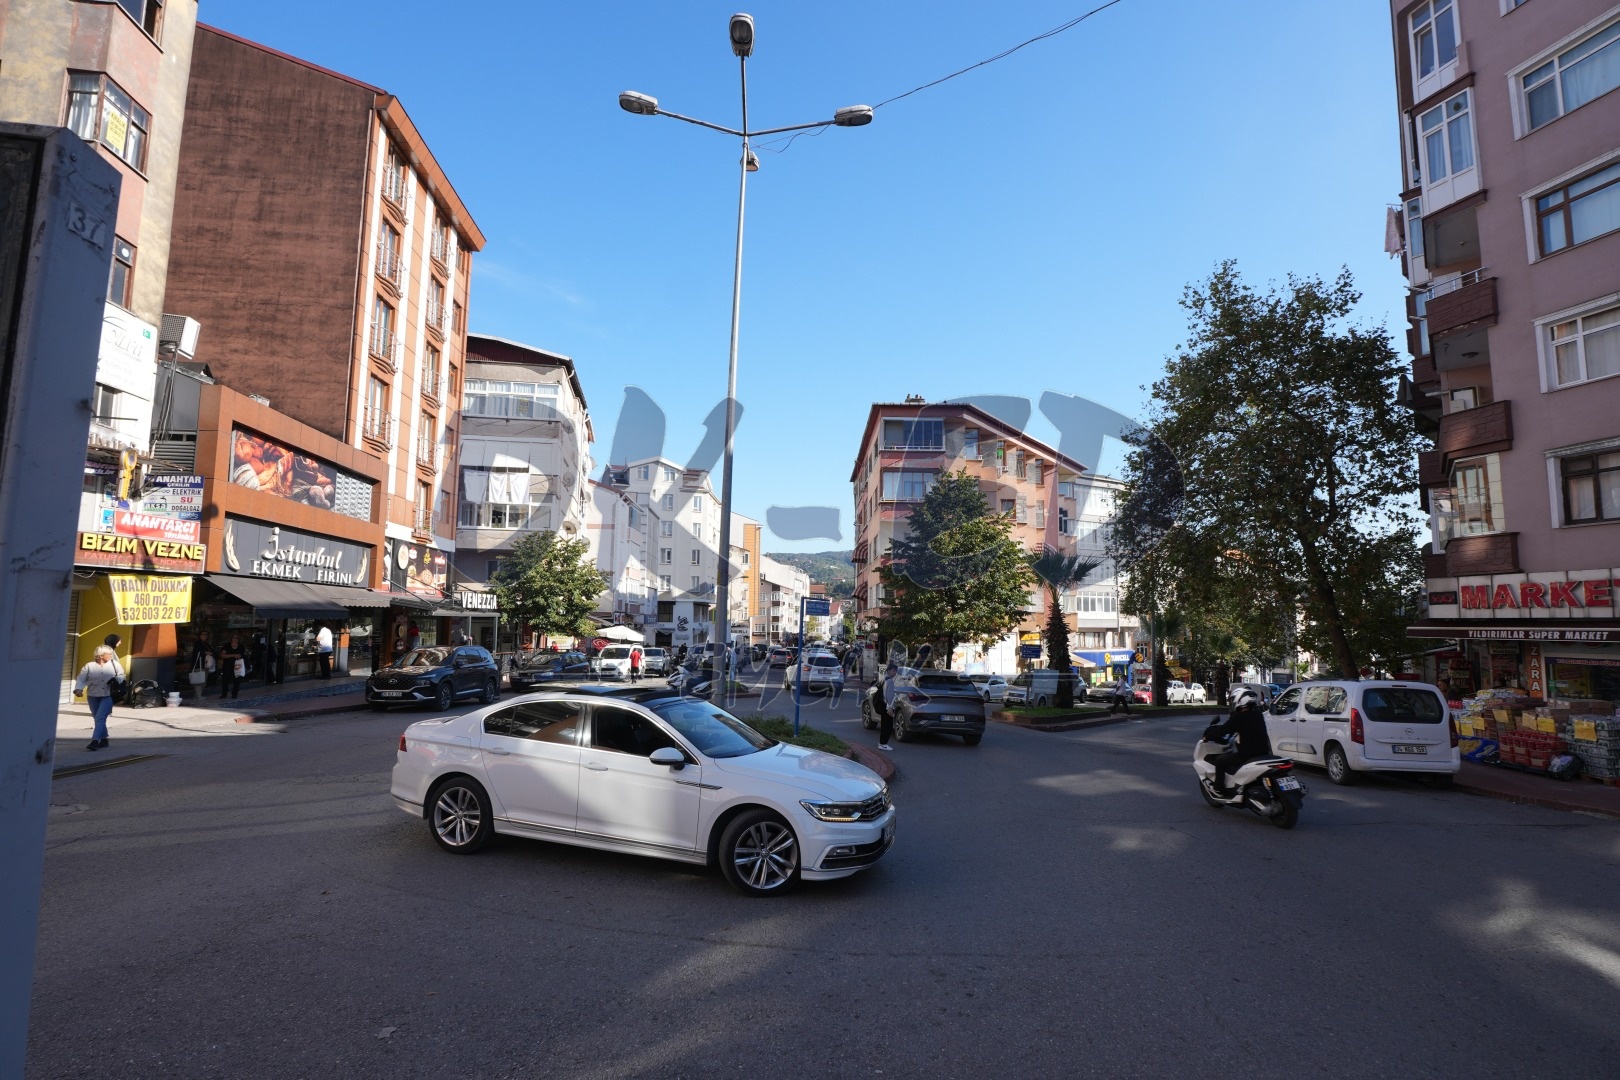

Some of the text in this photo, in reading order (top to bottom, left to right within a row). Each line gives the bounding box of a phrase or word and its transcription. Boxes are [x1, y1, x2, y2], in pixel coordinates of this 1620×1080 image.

[155, 475, 202, 484] ANAHTAR
[180, 496, 194, 504] SU
[121, 512, 196, 534] ANAHTARCI
[141, 540, 205, 561] VEZNE
[252, 560, 352, 584] EKMEK FIRINI
[134, 593, 168, 606] 460 m2
[142, 607, 160, 620] 603
[161, 607, 174, 620] 22
[1468, 629, 1609, 641] YILDIRIMLAR SÜPER MARKET
[1530, 646, 1541, 692] ZARA
